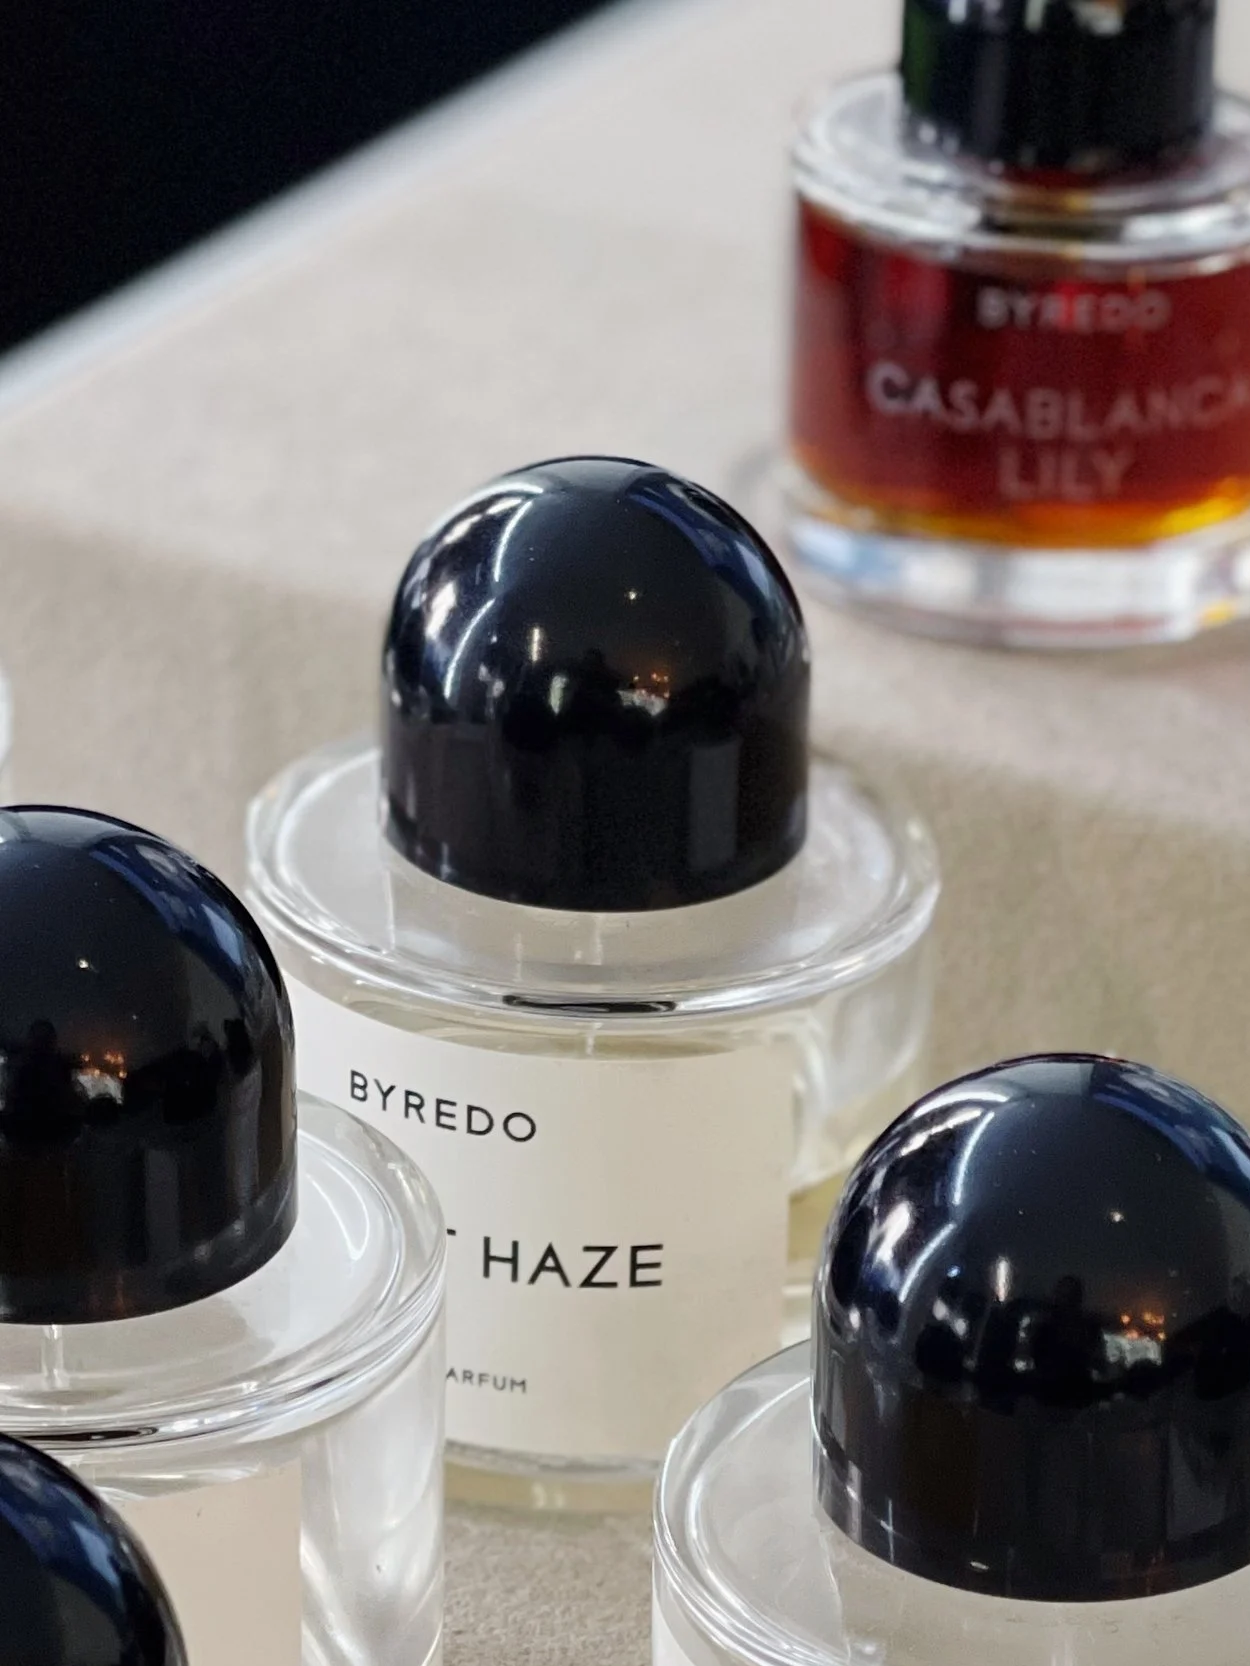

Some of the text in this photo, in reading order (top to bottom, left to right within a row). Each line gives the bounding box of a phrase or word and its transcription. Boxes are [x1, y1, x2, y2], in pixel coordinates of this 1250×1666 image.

[1001, 447, 1132, 499] LILY
[349, 1069, 537, 1142] BYREDO
[482, 1236, 664, 1288] HAZE
[446, 1367, 527, 1394] ARFUM
